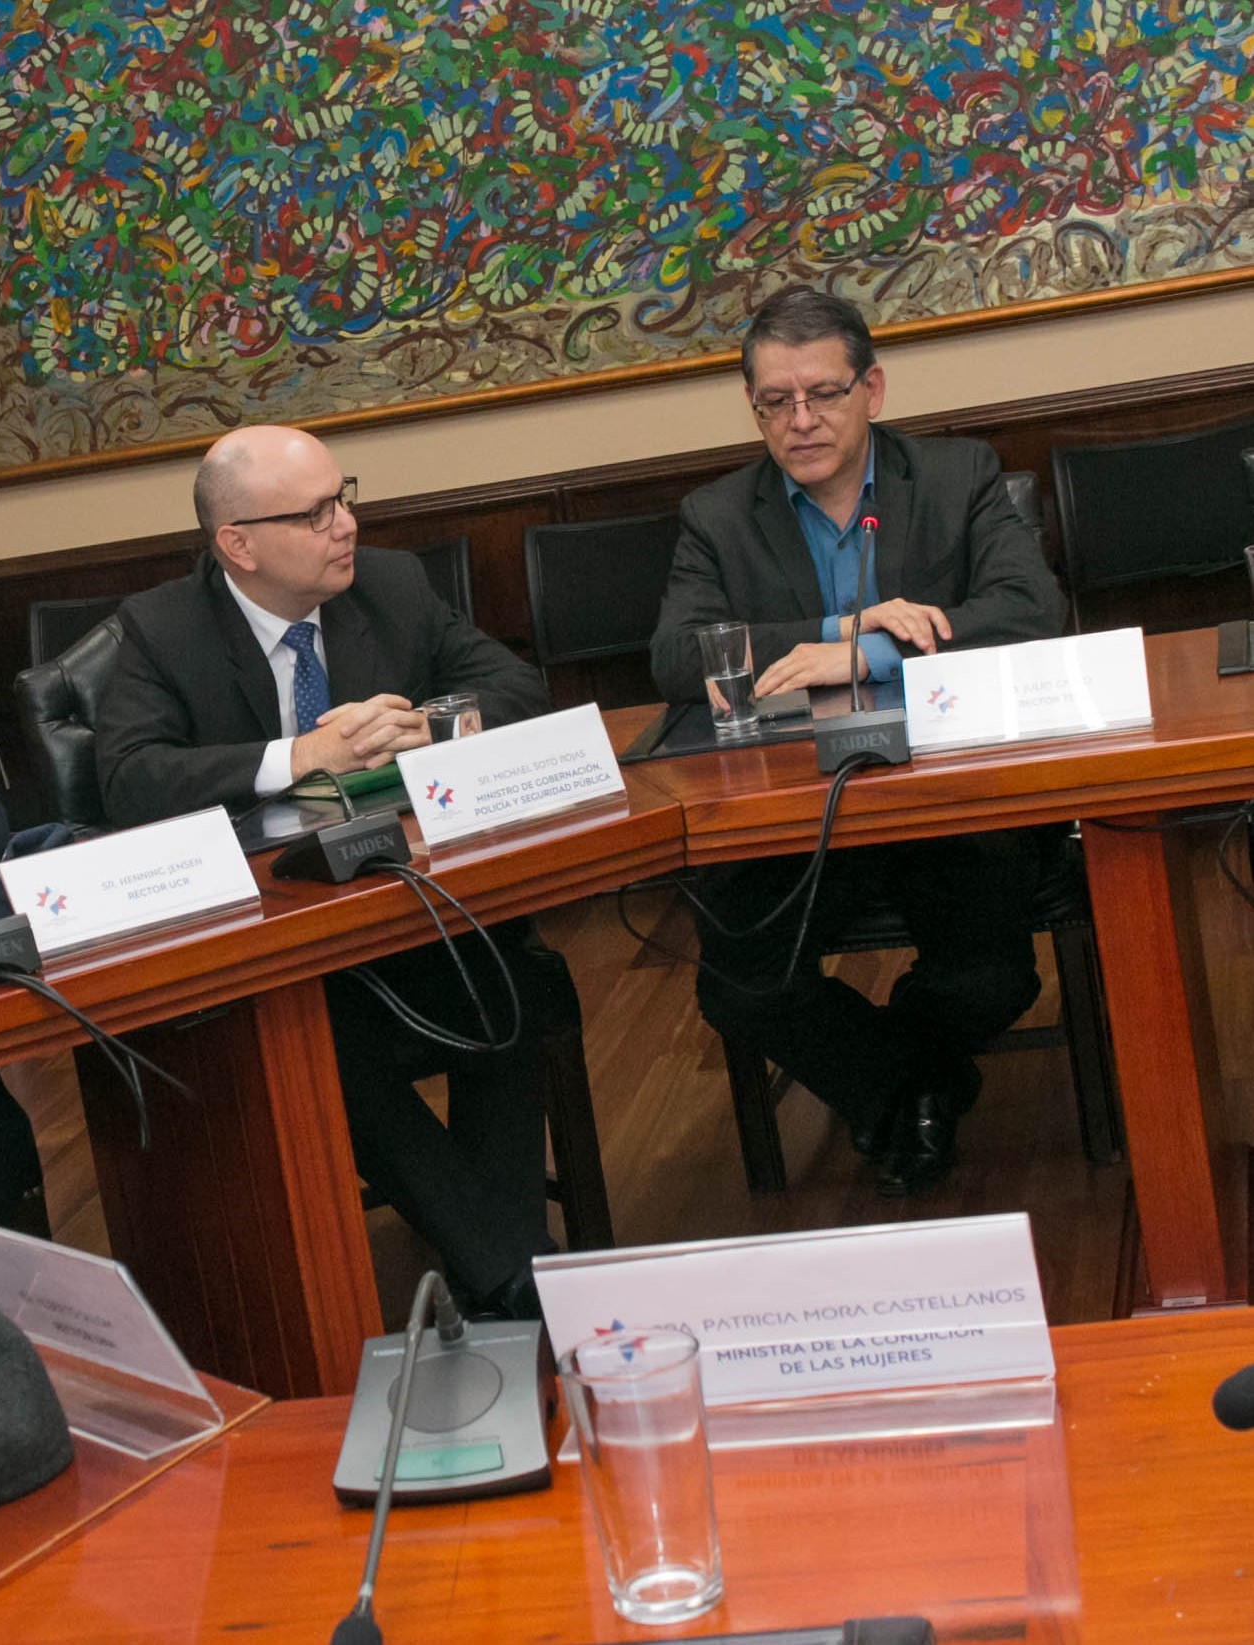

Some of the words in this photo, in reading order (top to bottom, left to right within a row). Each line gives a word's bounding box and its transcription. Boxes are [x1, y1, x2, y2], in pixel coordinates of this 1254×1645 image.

[828, 732, 891, 753] TAIDEN
[493, 765, 531, 781] MICHAEL
[533, 757, 558, 771] SOTO
[560, 749, 587, 764] ROJAS
[476, 785, 519, 802] MINISTRO
[521, 780, 534, 792] DE
[520, 783, 572, 805] SEGURIDAD
[338, 832, 395, 861] TAIDEN
[119, 866, 166, 886] HENNING
[168, 856, 204, 875] JENSEN
[126, 883, 168, 901] RECTOR
[169, 876, 190, 889] UCR
[701, 1311, 798, 1333] PATRICIA
[802, 1304, 867, 1323] MORA
[872, 1287, 1027, 1316] CASTELLANOS
[716, 1343, 806, 1362] MINISTRA
[810, 1339, 836, 1352] DE
[841, 1337, 866, 1350] LA
[779, 1361, 804, 1375] DE
[809, 1356, 845, 1372] LAS
[850, 1348, 933, 1368] MUJERES
